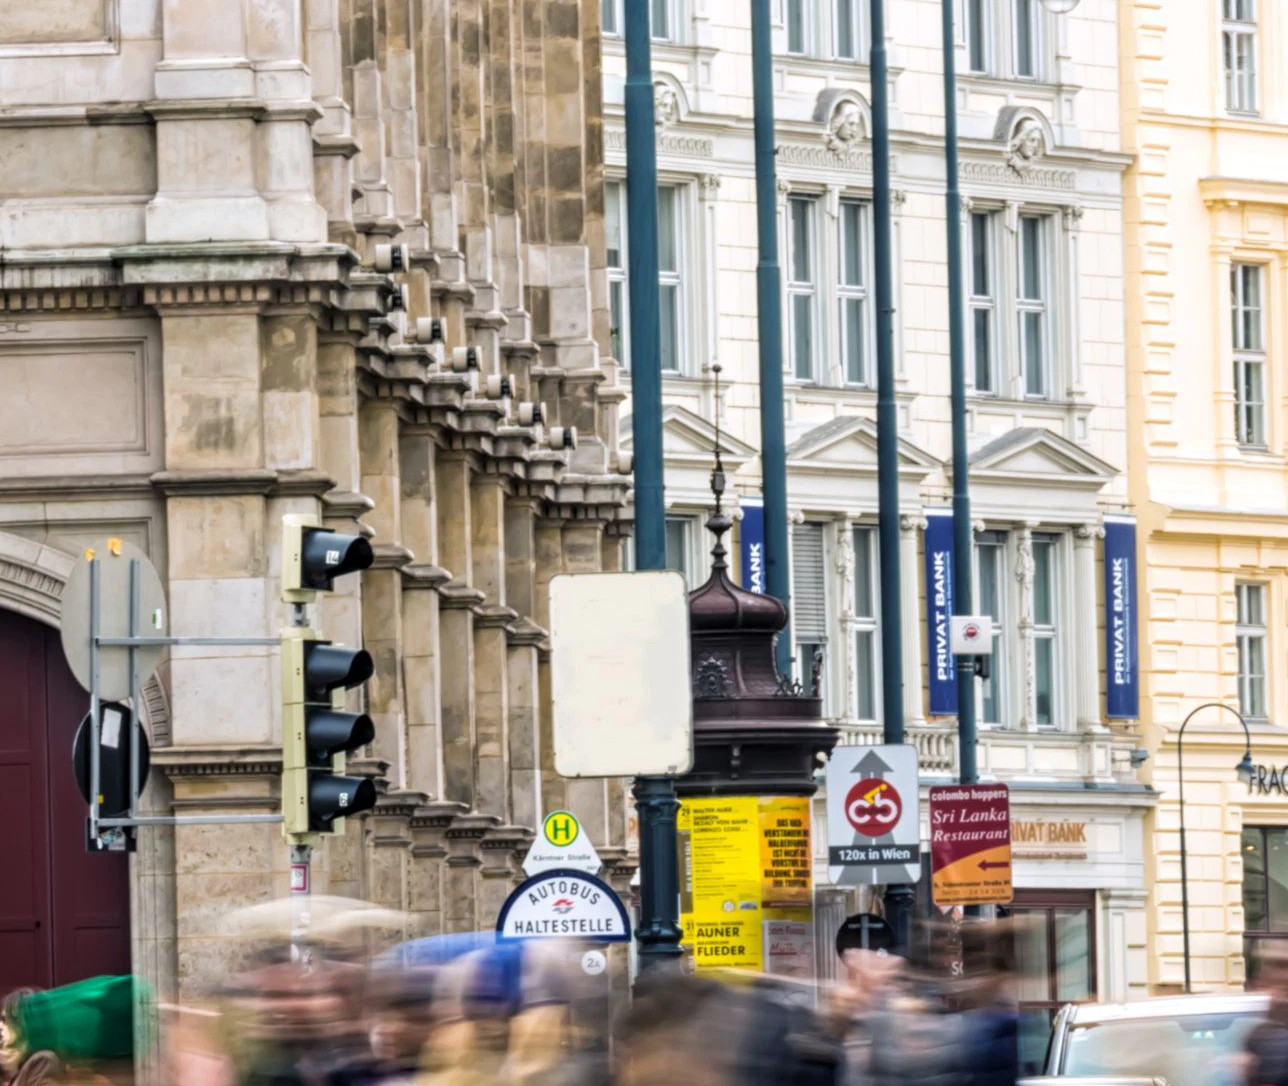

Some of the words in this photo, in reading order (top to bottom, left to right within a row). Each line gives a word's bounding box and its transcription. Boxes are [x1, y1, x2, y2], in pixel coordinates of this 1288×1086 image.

[750, 543, 761, 595] BANK
[933, 551, 946, 606] BANK
[1112, 557, 1124, 611] BANK
[935, 611, 948, 681] PRIVAT
[1113, 616, 1125, 684] PRIVAT
[932, 790, 969, 801] colombo
[971, 788, 1008, 802] hoppers
[933, 808, 956, 824] Sri
[960, 807, 1007, 823] Lanka
[553, 819, 570, 840] H
[934, 828, 1008, 842] Restaurant
[1048, 822, 1087, 842] BANK
[838, 849, 866, 861] 120x
[868, 848, 880, 860] in
[881, 846, 911, 860] Wien
[528, 881, 601, 905] AUTOBUS
[514, 918, 613, 934] HALTESTELLE
[696, 926, 740, 938] AUNER
[697, 945, 746, 956] FLIEDER
